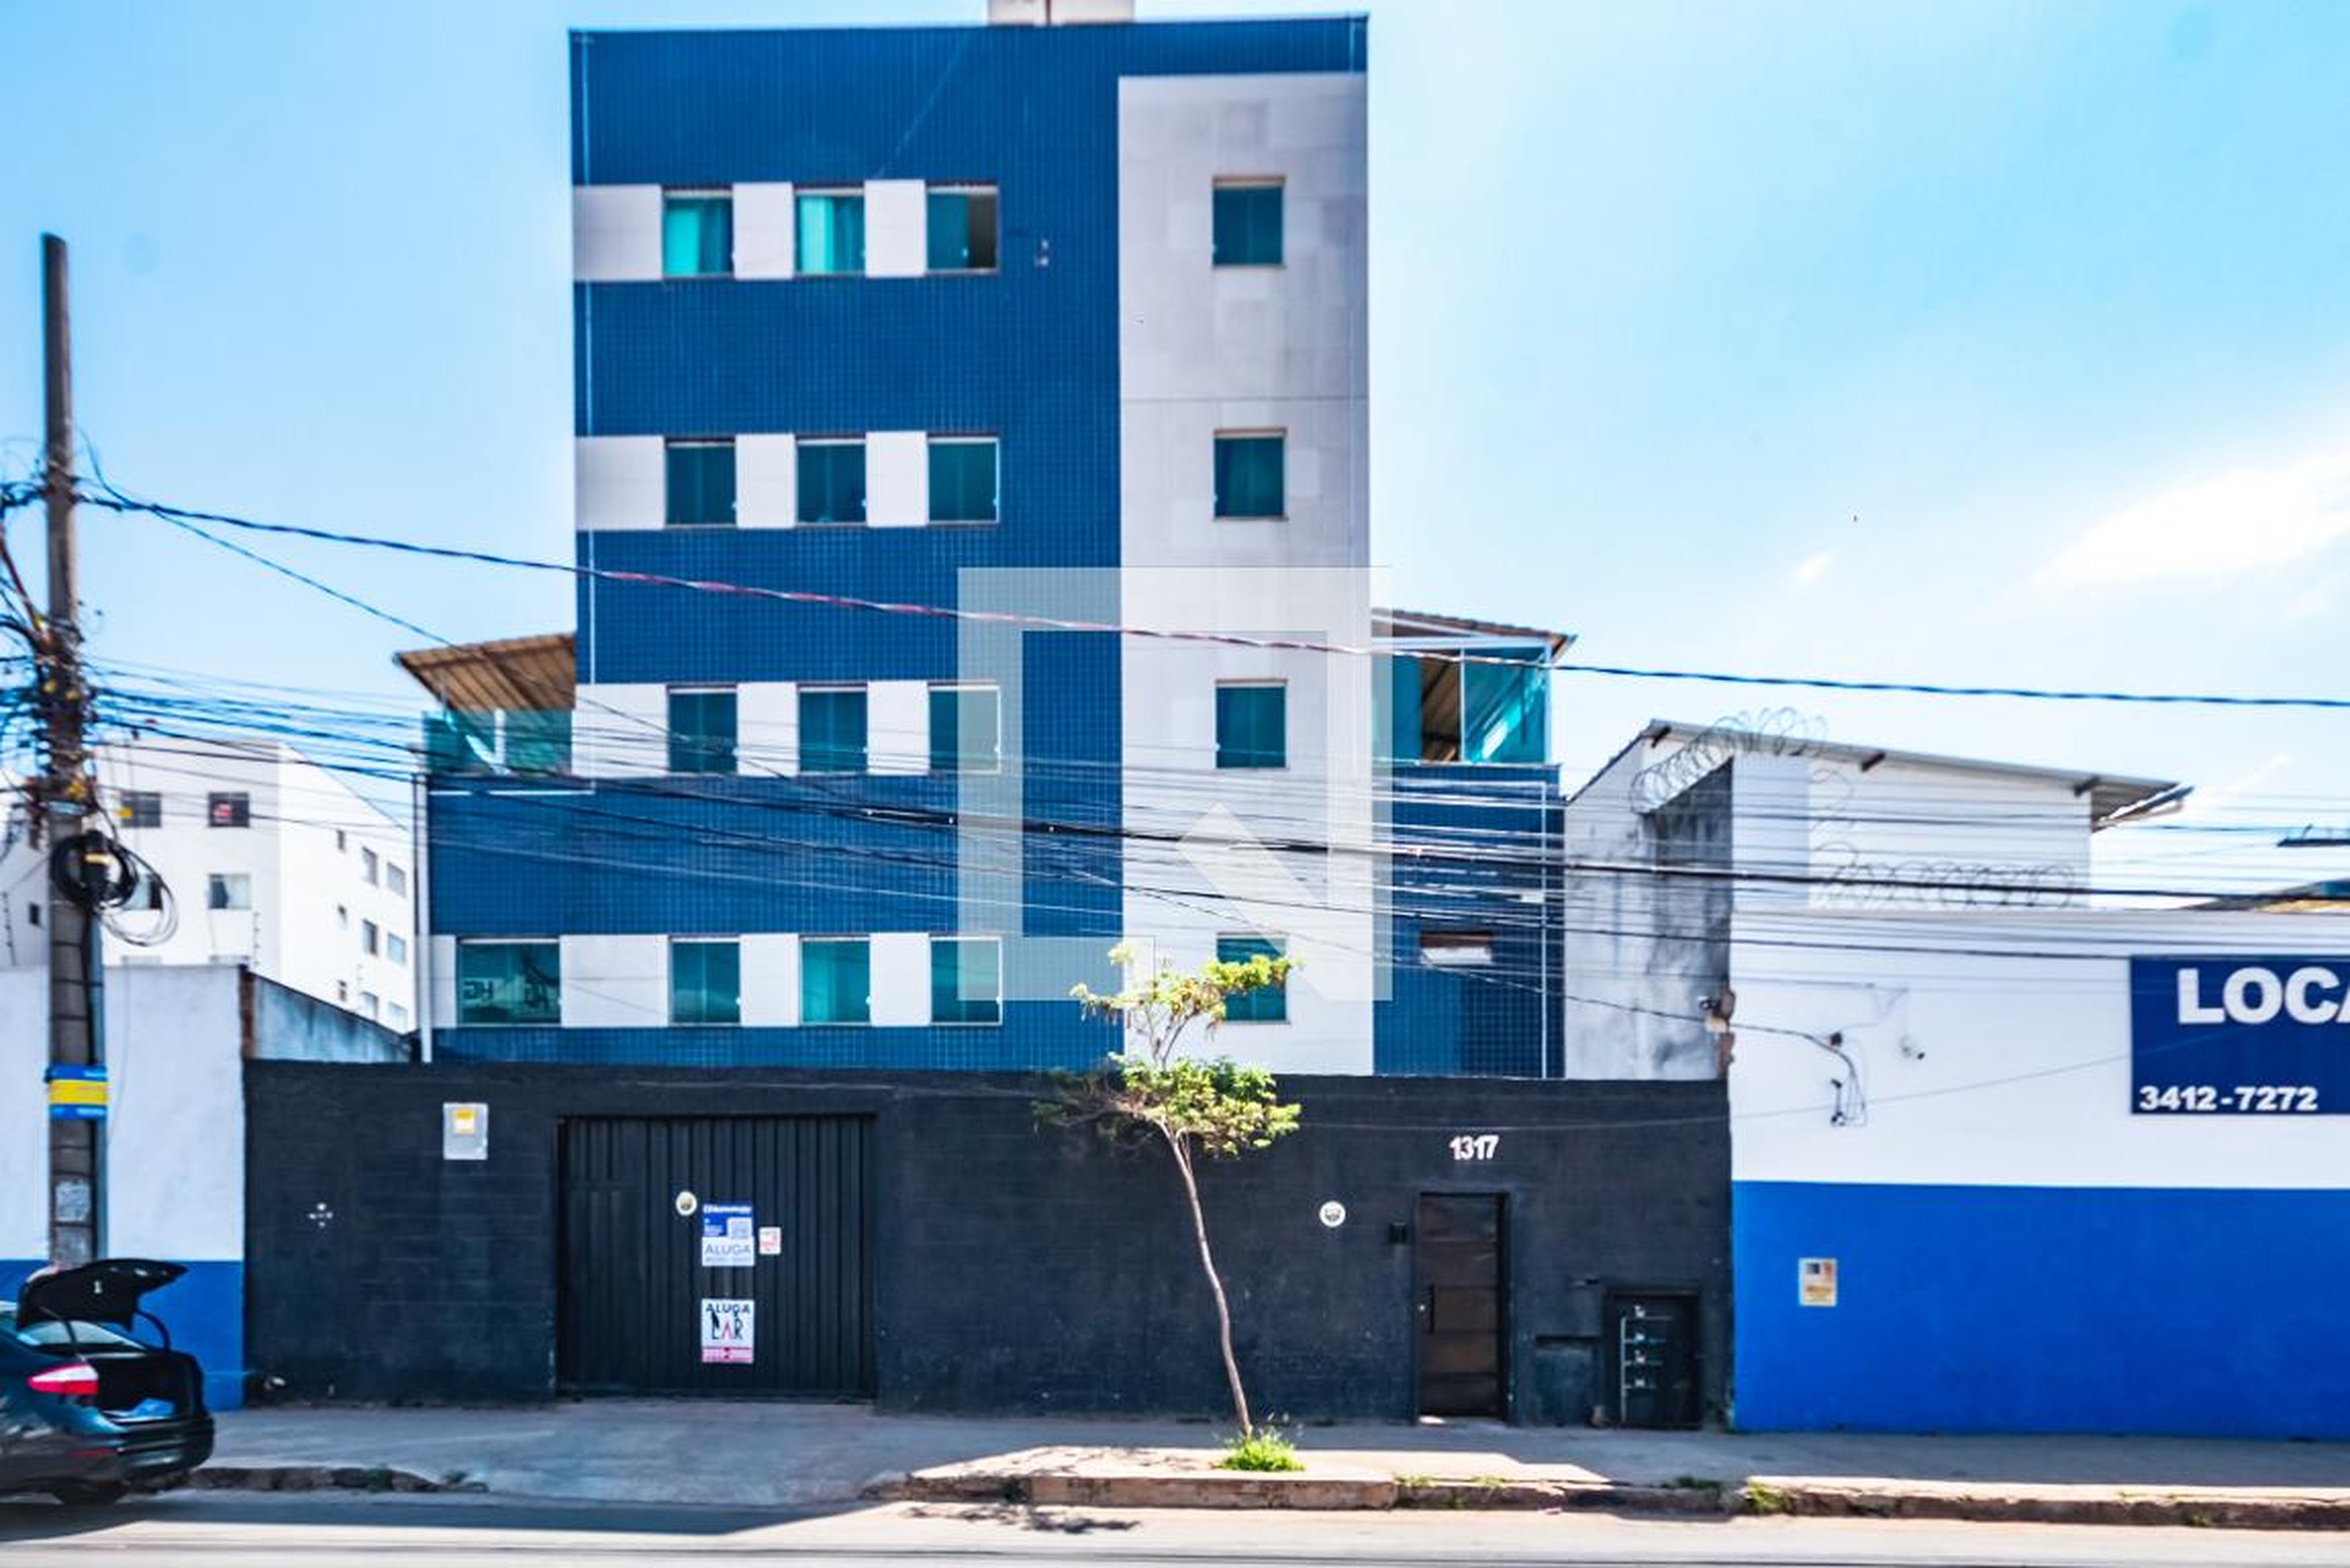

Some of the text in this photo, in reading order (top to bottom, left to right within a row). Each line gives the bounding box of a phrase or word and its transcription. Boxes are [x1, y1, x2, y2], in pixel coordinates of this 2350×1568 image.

[2177, 966, 2350, 1025] LOC
[2139, 1086, 2318, 1111] 3412-7272
[1449, 1135, 1499, 1160] 1317
[704, 1244, 751, 1255] ALUGA
[706, 1304, 751, 1314] ALUGA
